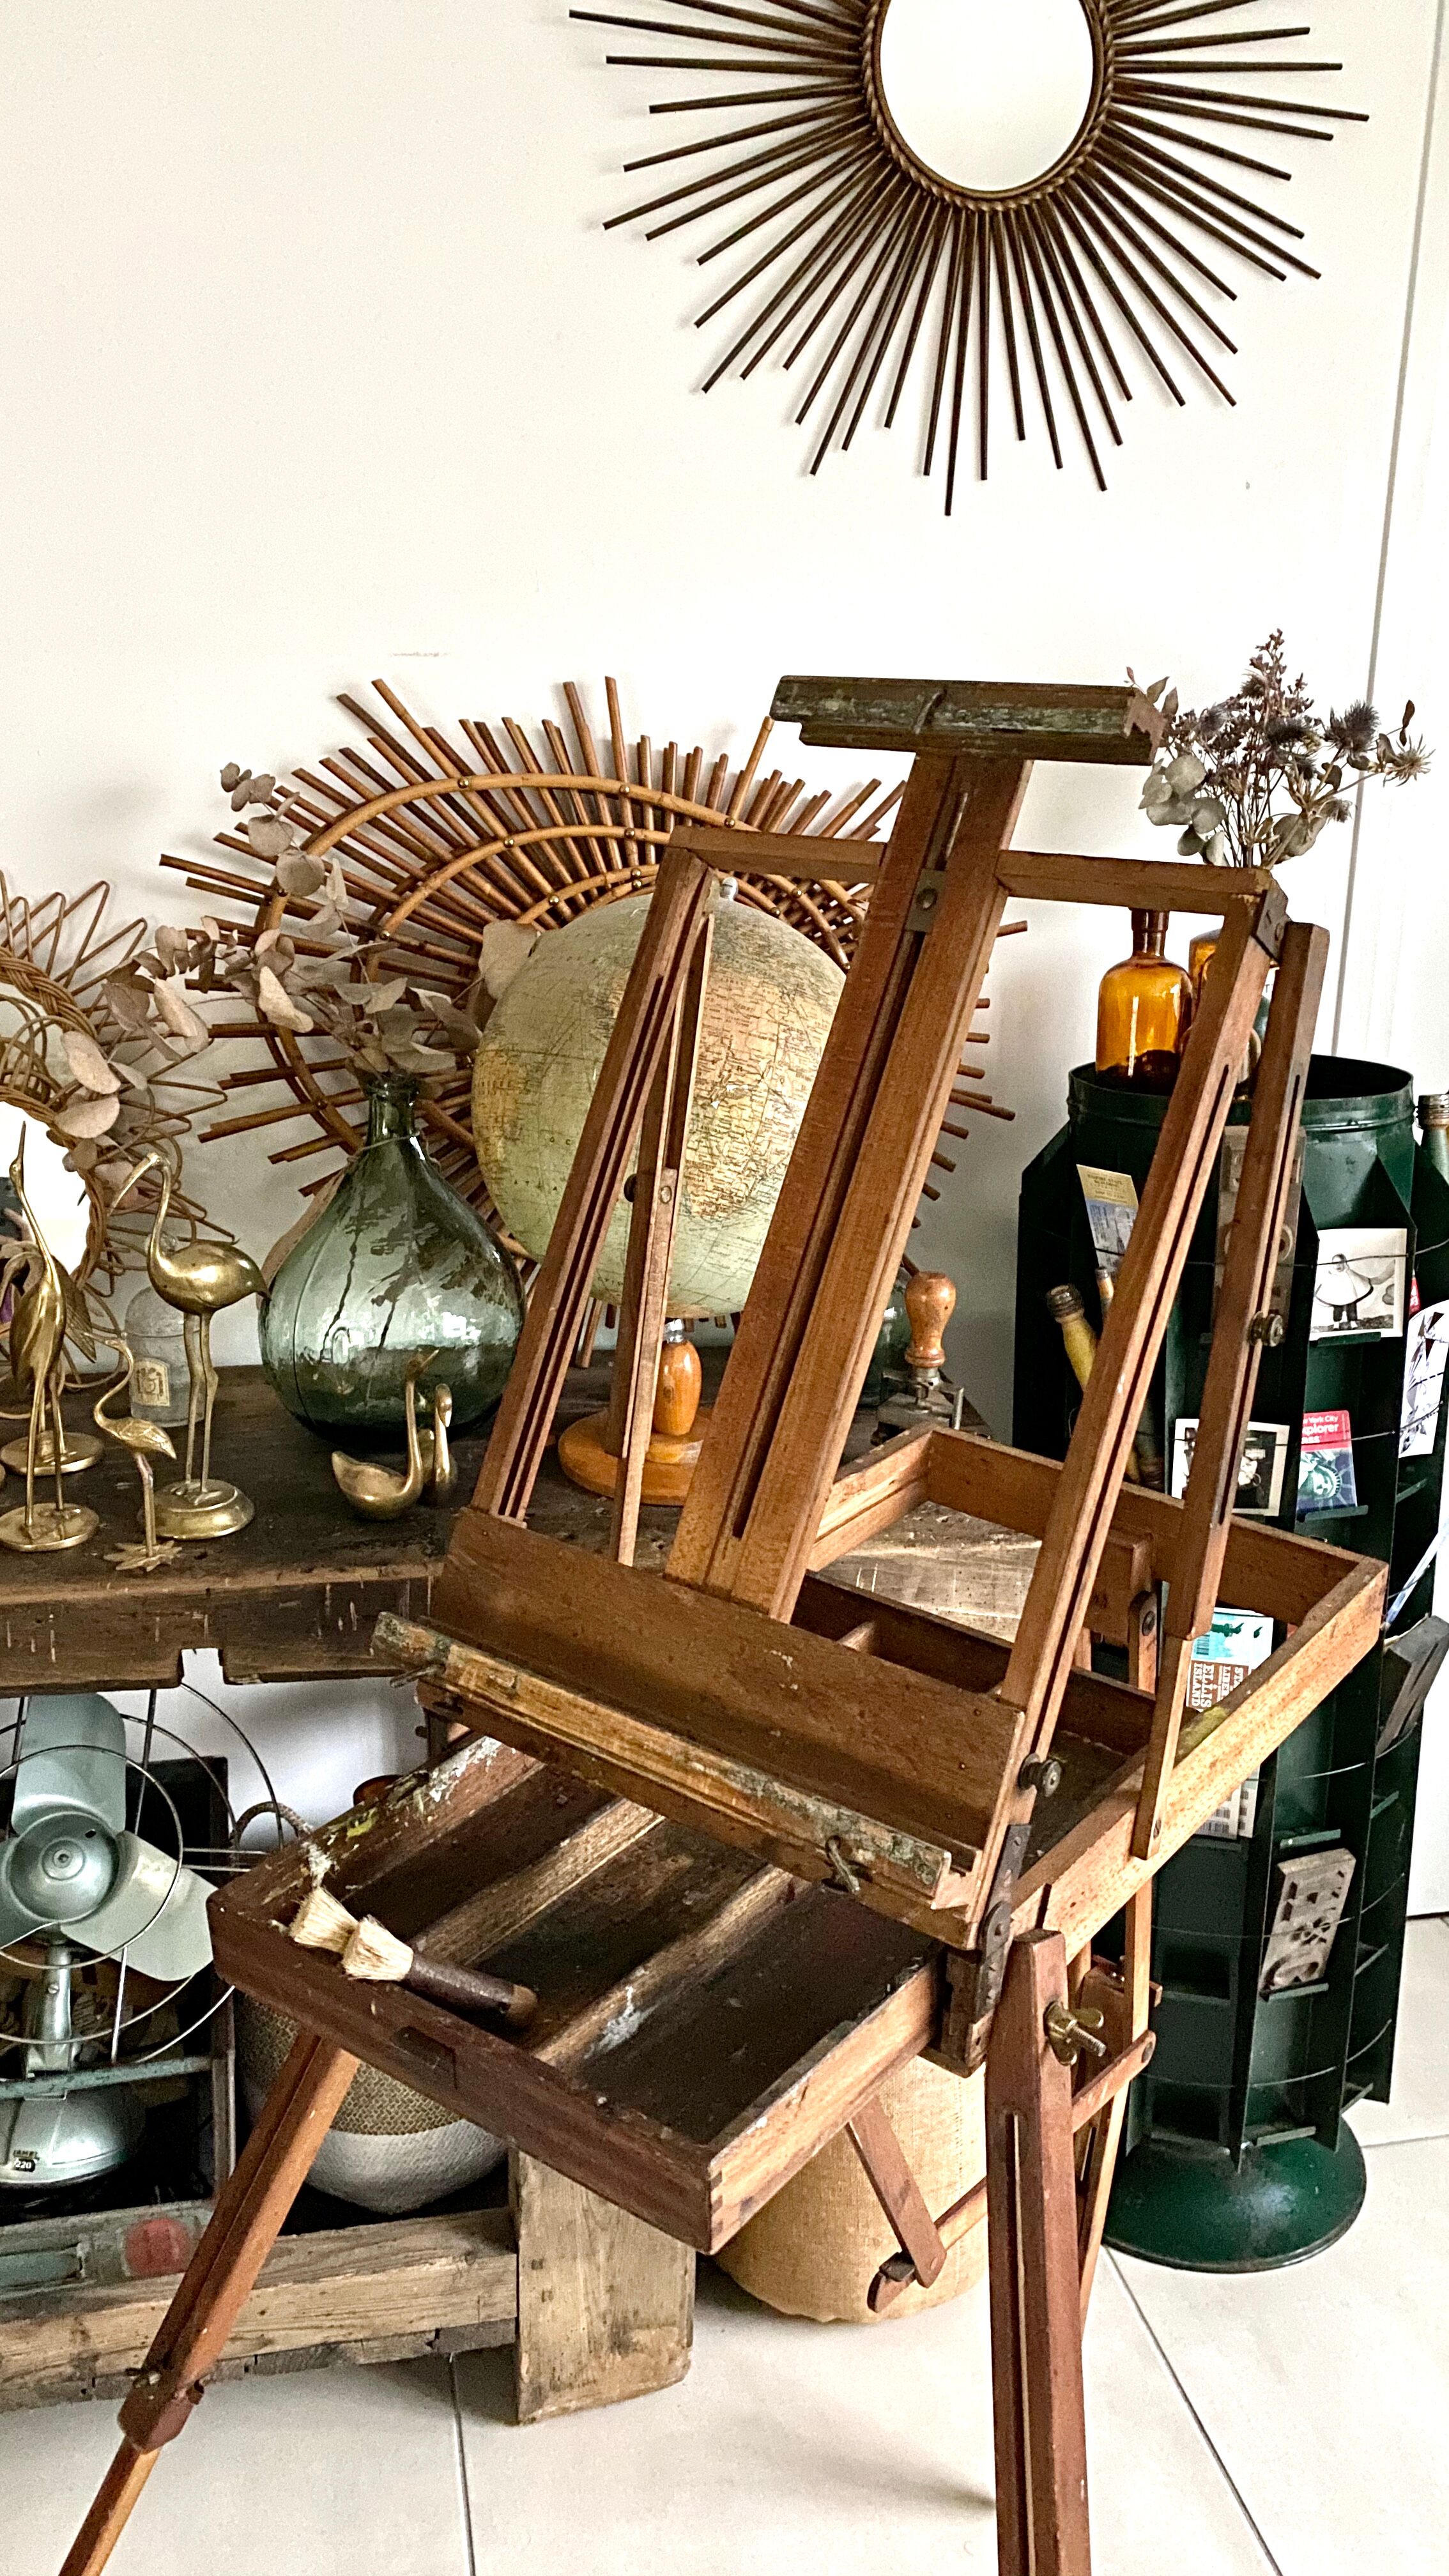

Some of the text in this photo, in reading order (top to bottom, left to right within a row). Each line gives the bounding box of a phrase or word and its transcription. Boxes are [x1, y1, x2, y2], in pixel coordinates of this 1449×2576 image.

[1301, 1436, 1321, 1445] ass
[1303, 1423, 1339, 1436] xplorer
[1191, 1662, 1203, 1706] ISLAND
[1200, 1664, 1215, 1708] ELLIS
[1221, 1666, 1232, 1698] LIBER
[1233, 1666, 1244, 1689] STA
[15, 2161, 32, 2169] 220
